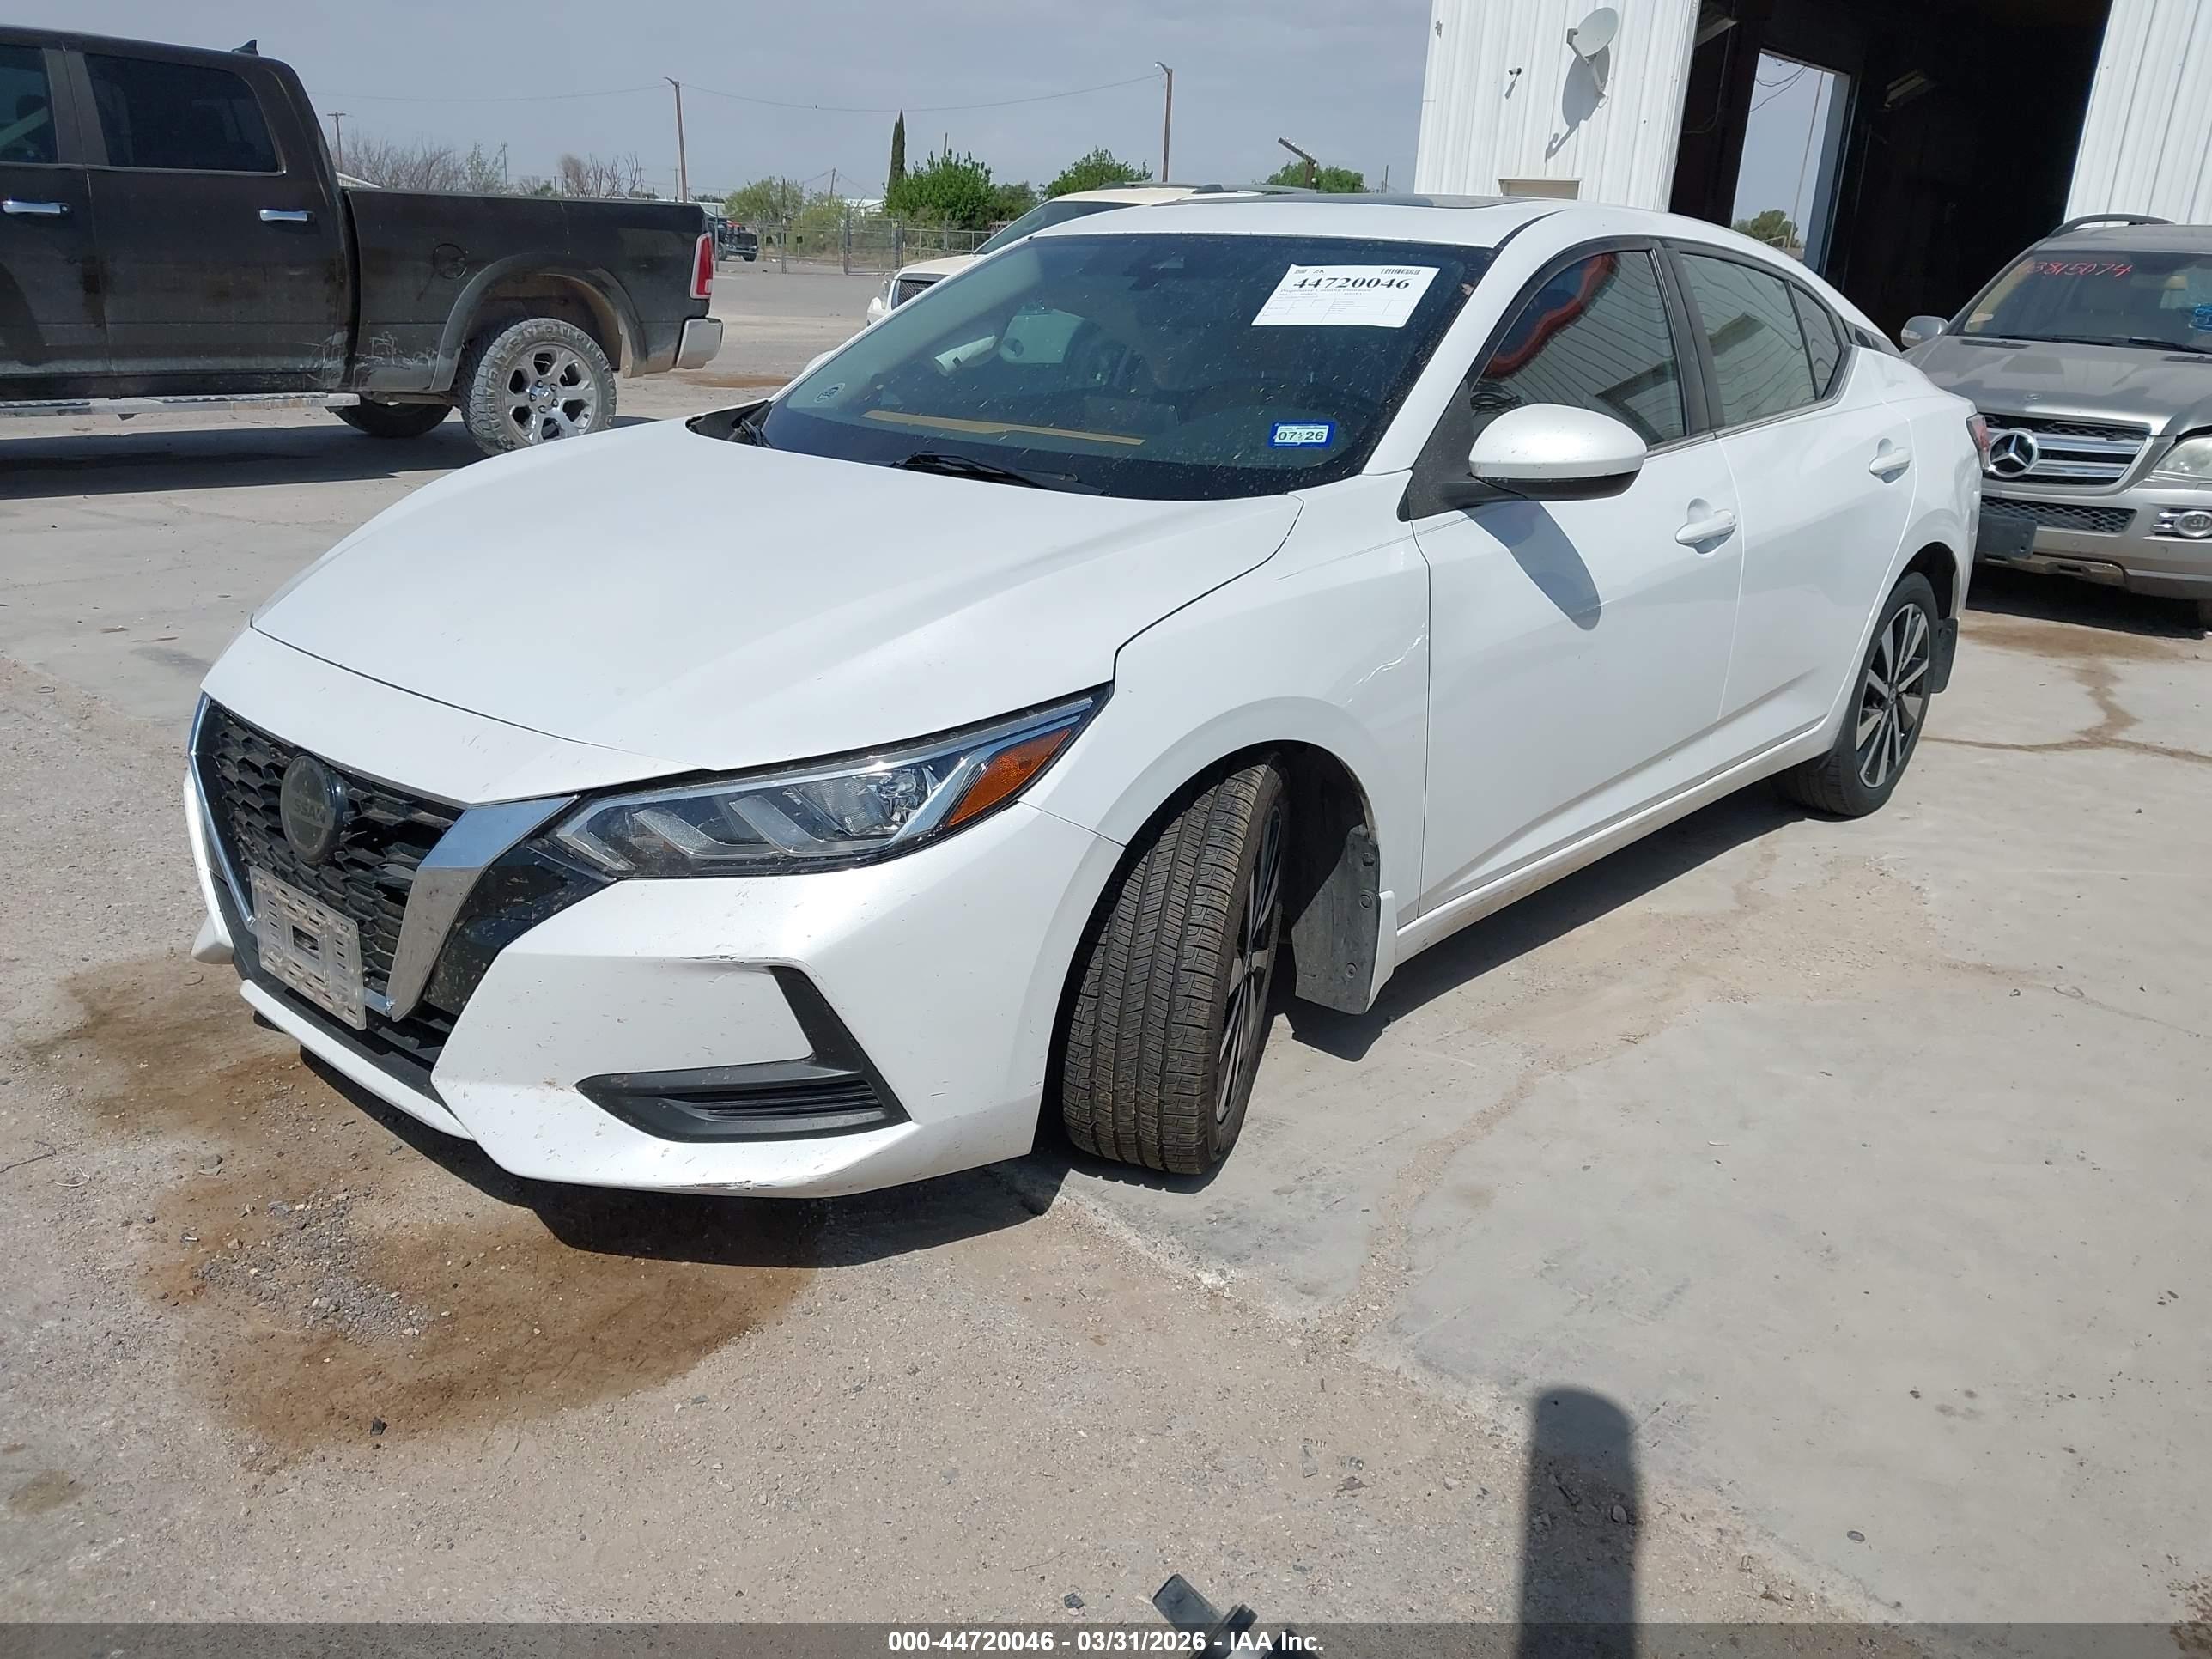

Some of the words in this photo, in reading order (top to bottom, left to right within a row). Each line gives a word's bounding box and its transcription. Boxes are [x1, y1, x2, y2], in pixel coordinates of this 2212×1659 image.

[1293, 277, 1412, 289] 44720046
[1278, 431, 1297, 441] 07
[1304, 431, 1324, 441] 26
